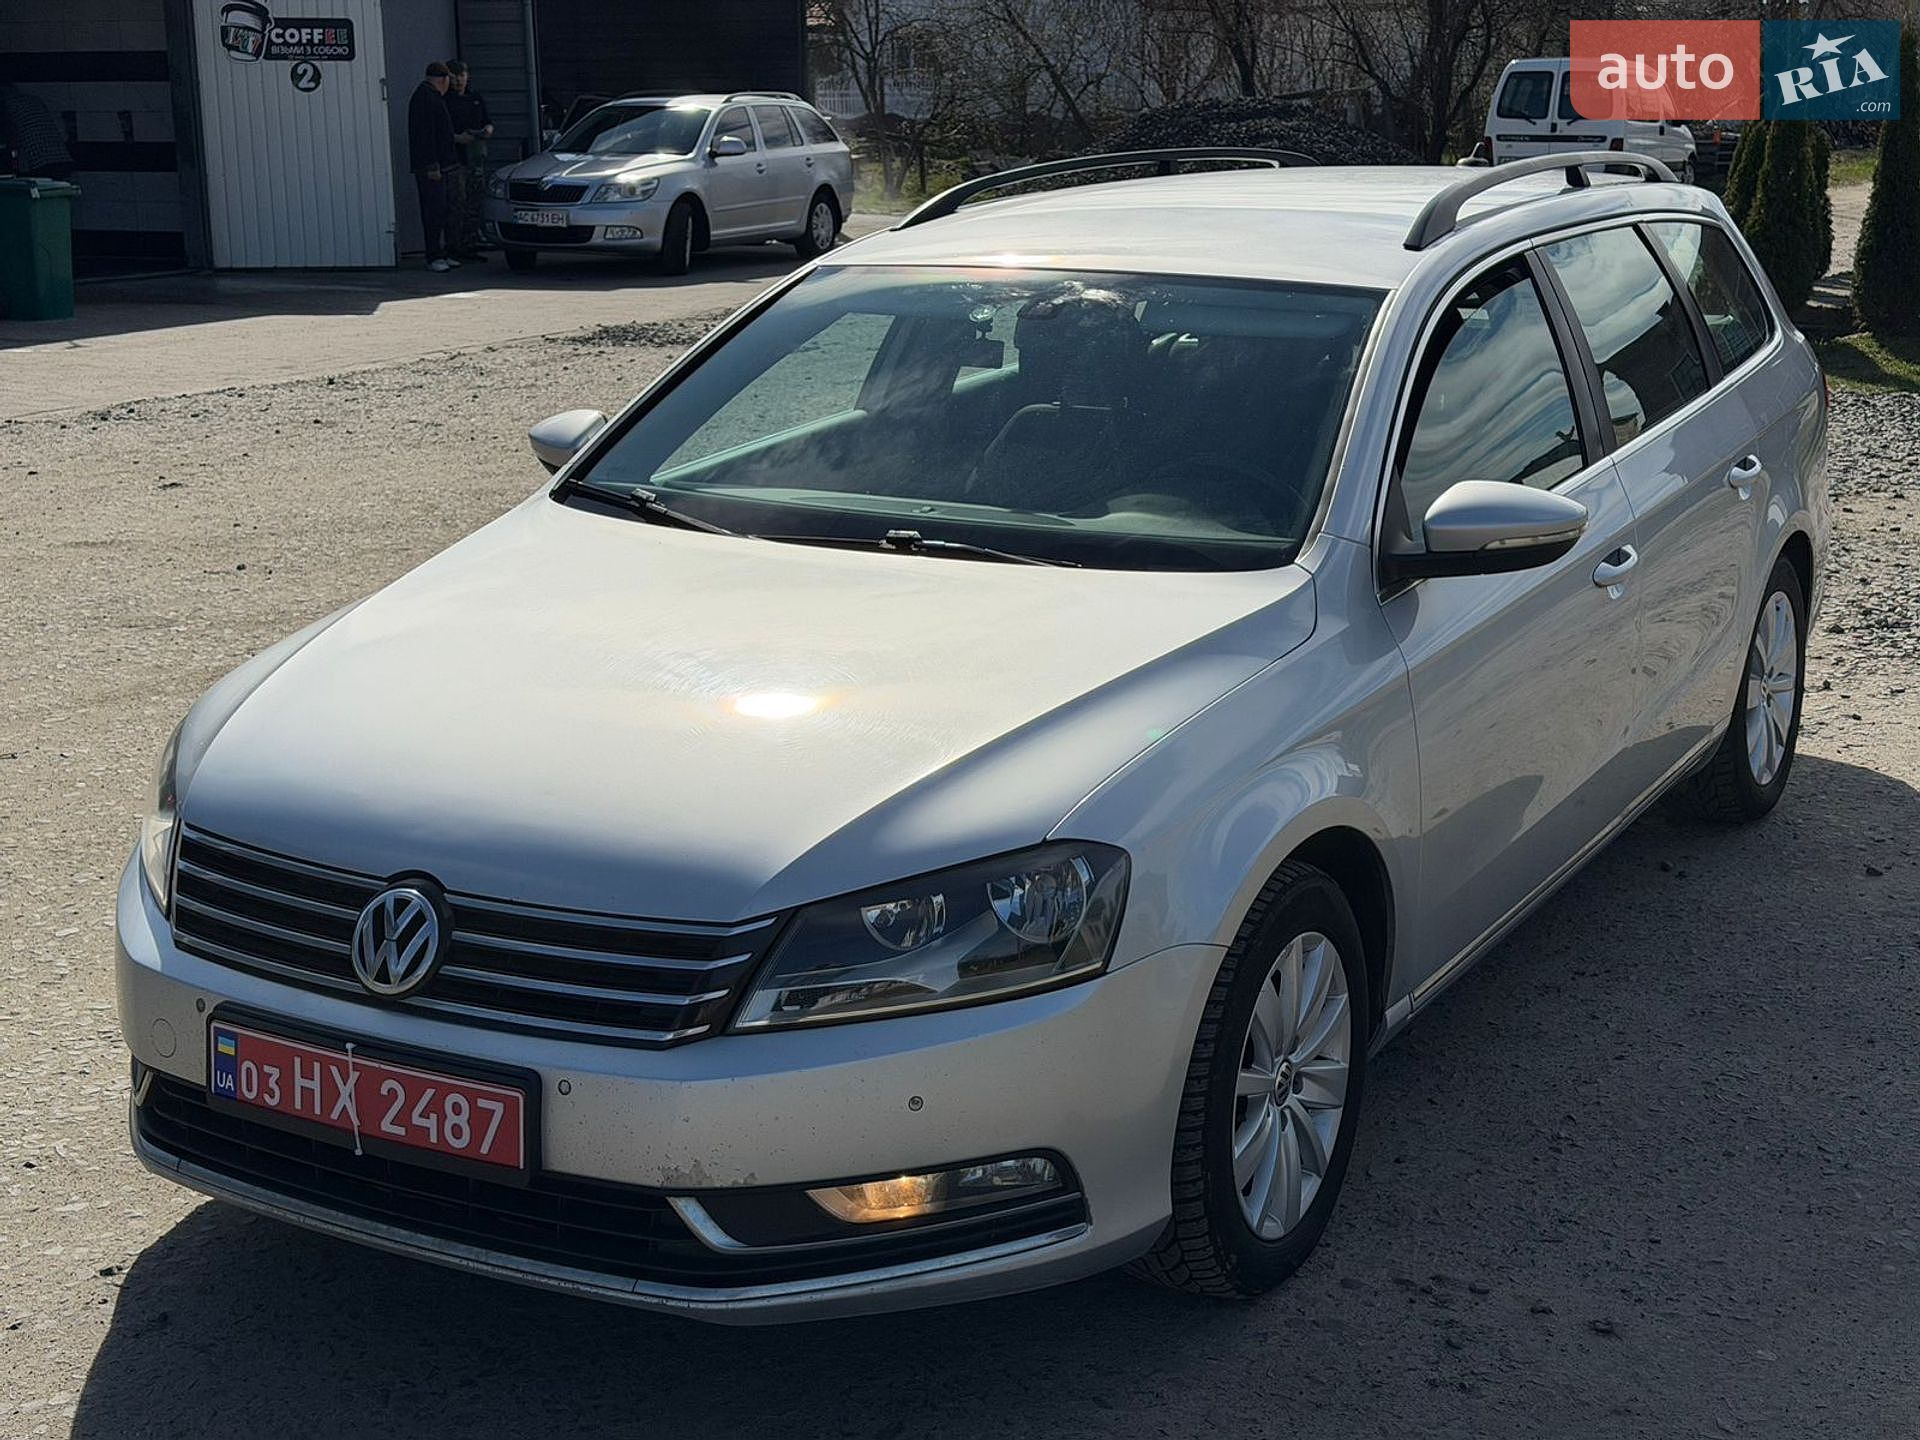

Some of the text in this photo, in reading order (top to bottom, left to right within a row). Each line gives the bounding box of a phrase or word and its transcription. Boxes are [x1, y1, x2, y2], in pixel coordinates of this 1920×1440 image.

[269, 28, 348, 44] COFFEE
[297, 63, 316, 89] 2
[216, 1070, 234, 1092] UA
[240, 1056, 505, 1156] 03 HX 2487
